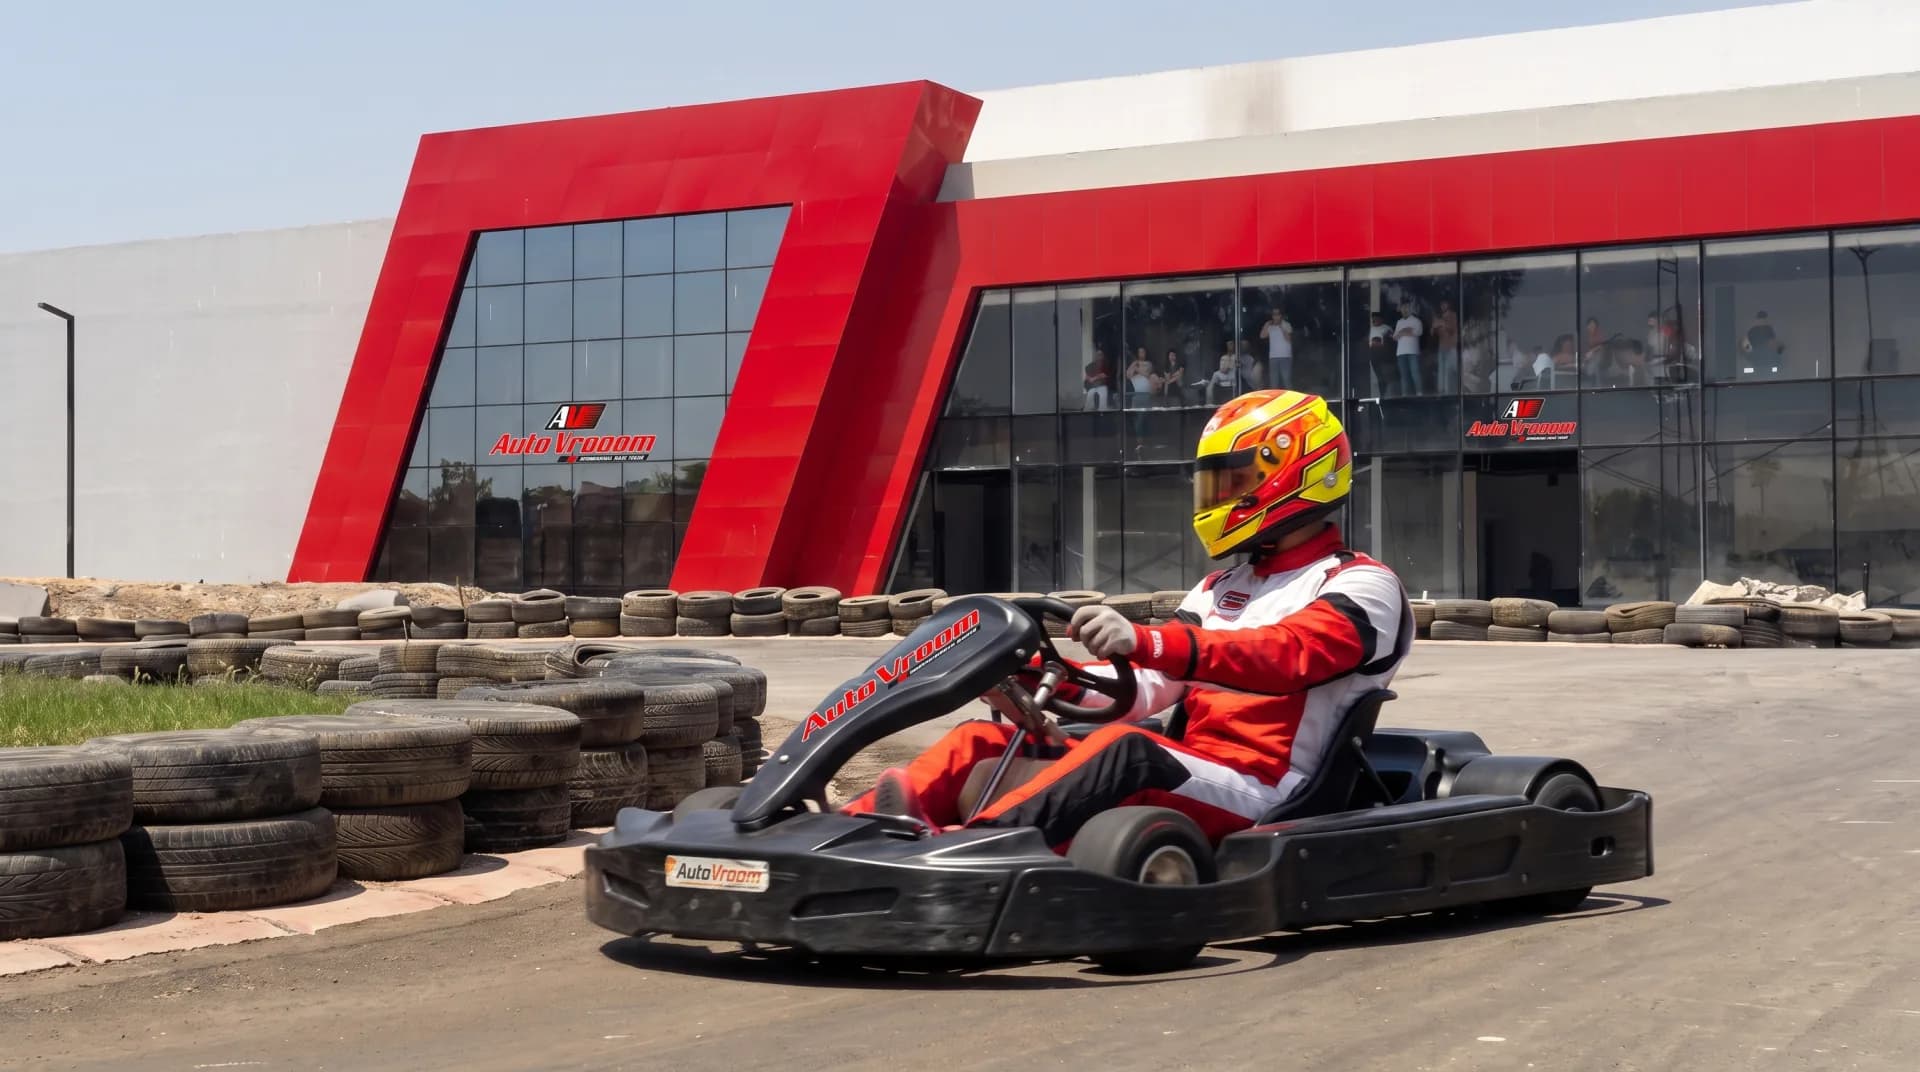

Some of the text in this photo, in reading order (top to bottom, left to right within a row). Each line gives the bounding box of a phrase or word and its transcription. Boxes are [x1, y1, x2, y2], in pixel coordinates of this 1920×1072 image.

[489, 432, 657, 455] Auto Vrooom
[802, 679, 876, 742] Auto
[875, 609, 980, 684] Vroom
[676, 862, 763, 884] AutoVroom
